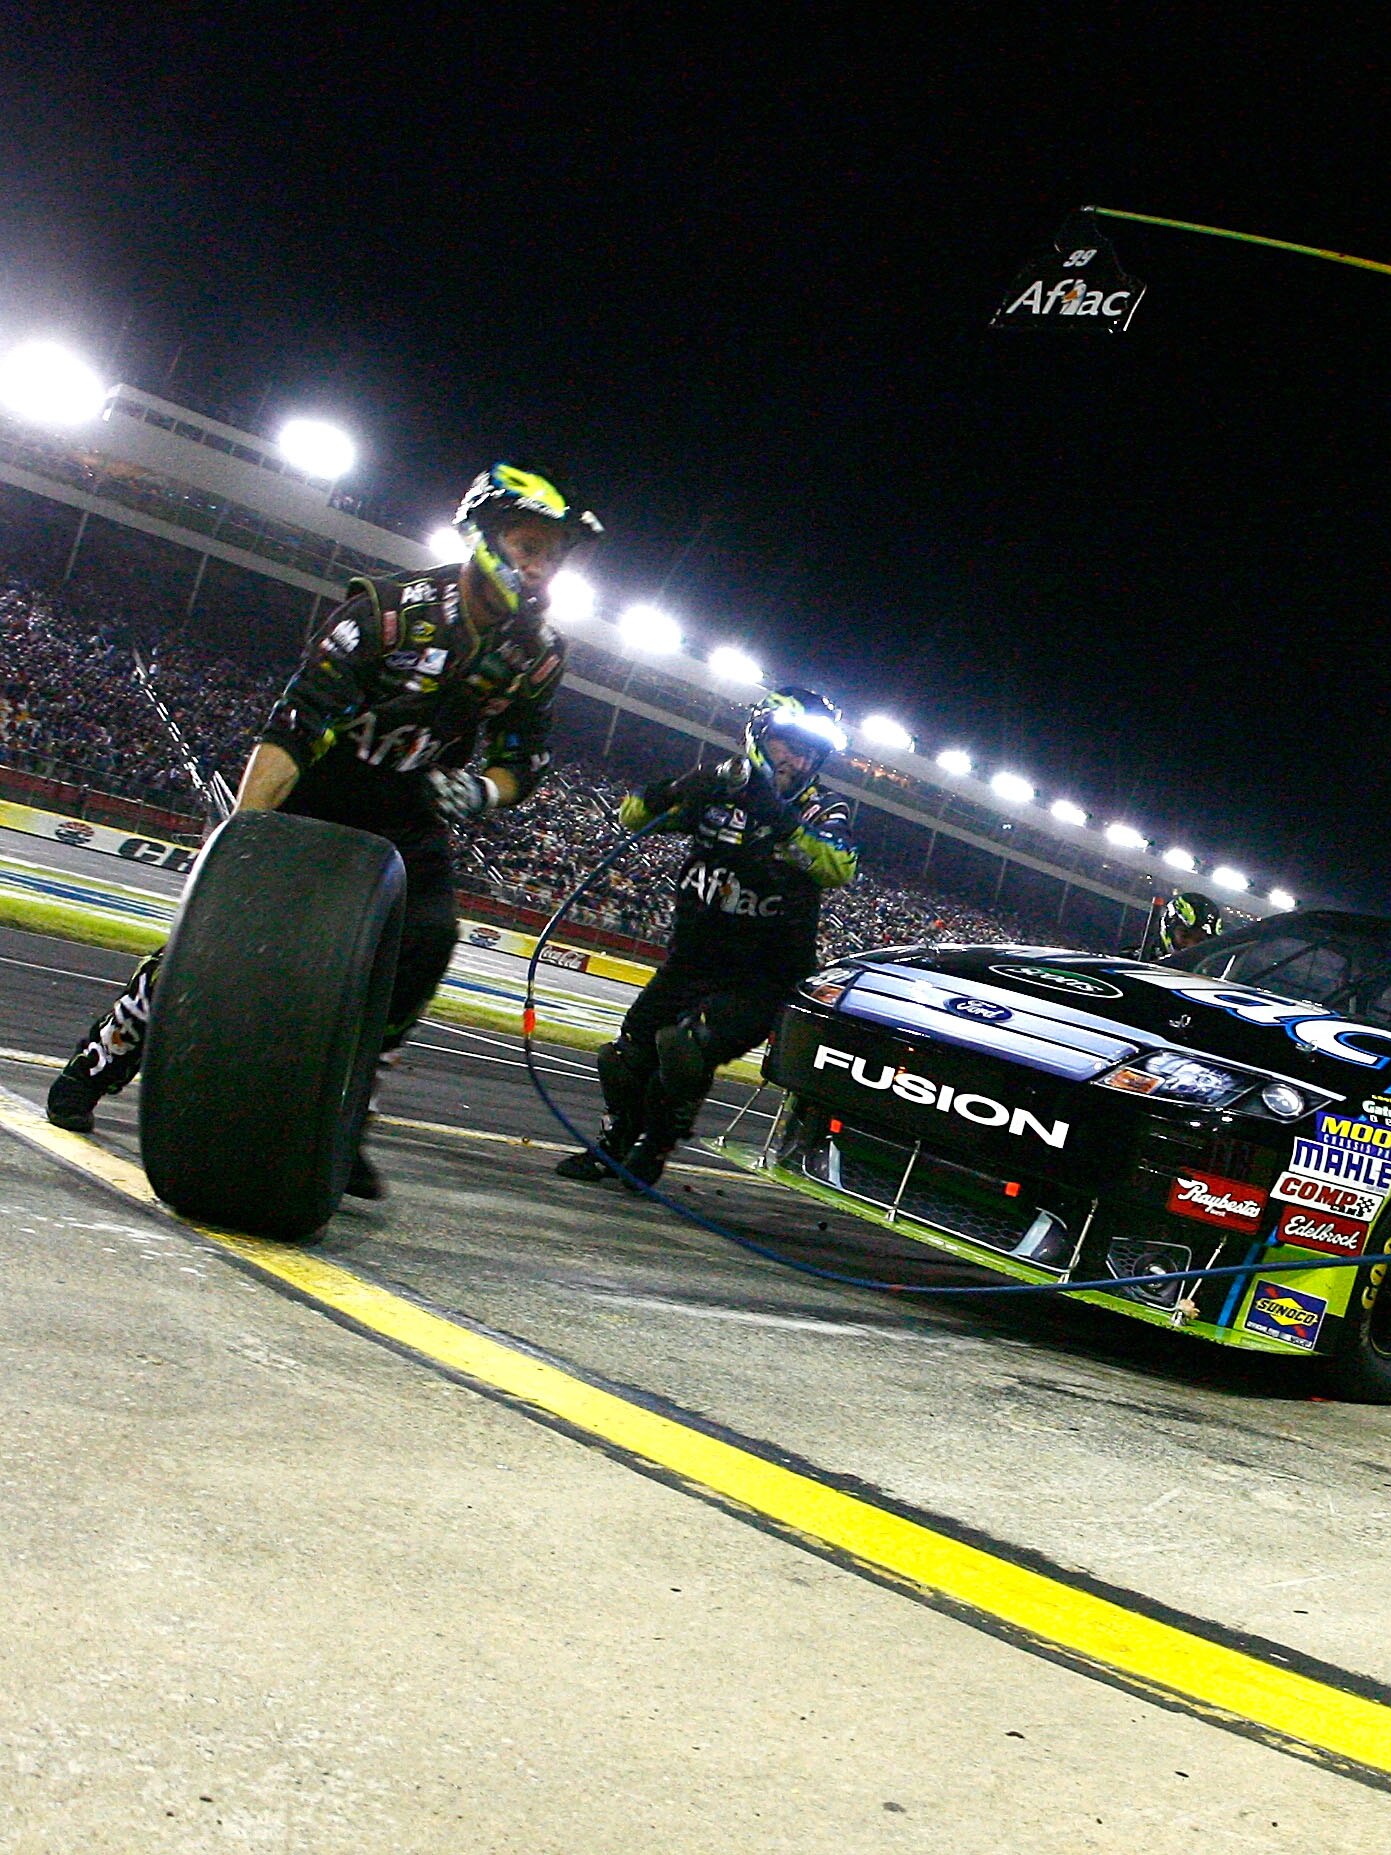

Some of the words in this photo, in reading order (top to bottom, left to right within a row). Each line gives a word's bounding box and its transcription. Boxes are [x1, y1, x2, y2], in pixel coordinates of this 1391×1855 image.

[1063, 249, 1097, 267] 99
[1006, 278, 1131, 317] Aflac
[680, 862, 783, 918] Aflac
[956, 1000, 1005, 1020] Ford
[813, 1044, 1070, 1149] FUSION
[1323, 1133, 1371, 1154] CHASSIS
[1279, 1176, 1359, 1207] COMP
[1284, 1215, 1360, 1250] Edelbrock
[1257, 1299, 1317, 1325] SUNOCO
